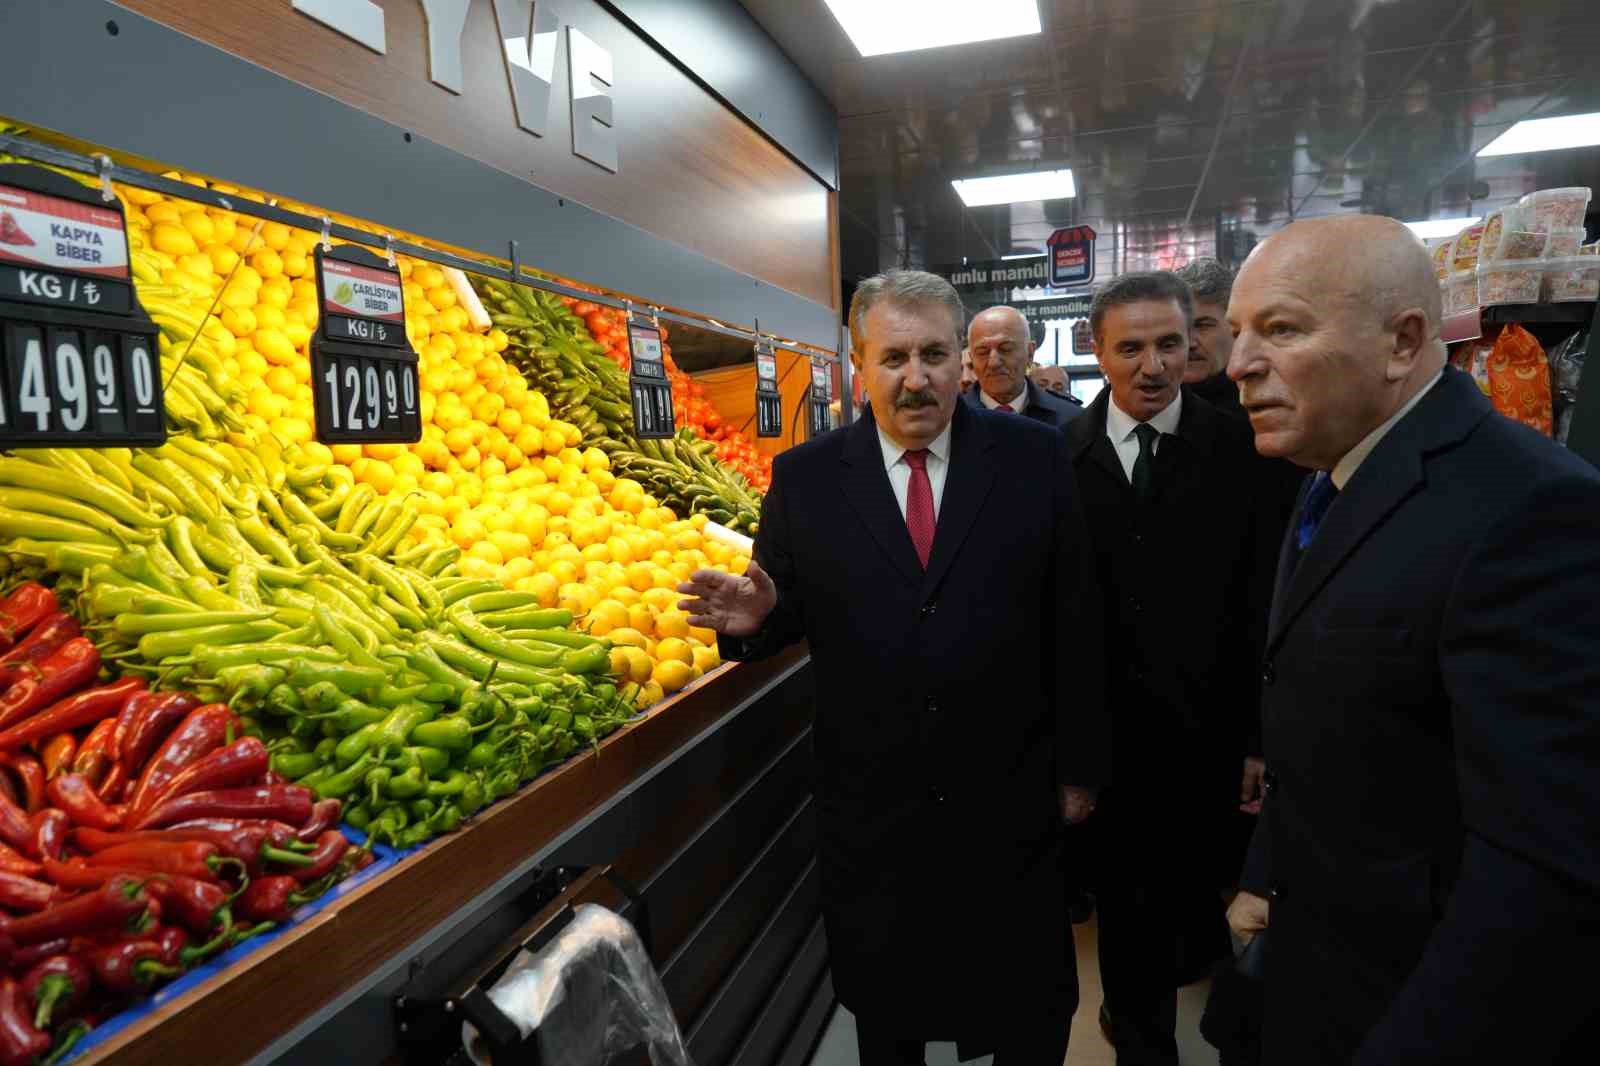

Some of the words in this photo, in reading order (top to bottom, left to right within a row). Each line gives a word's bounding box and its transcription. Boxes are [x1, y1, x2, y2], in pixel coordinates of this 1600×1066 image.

[51, 223, 104, 246] KAPYA
[56, 242, 102, 263] BİBER
[952, 269, 987, 284] unlu
[991, 262, 1048, 281] mamül
